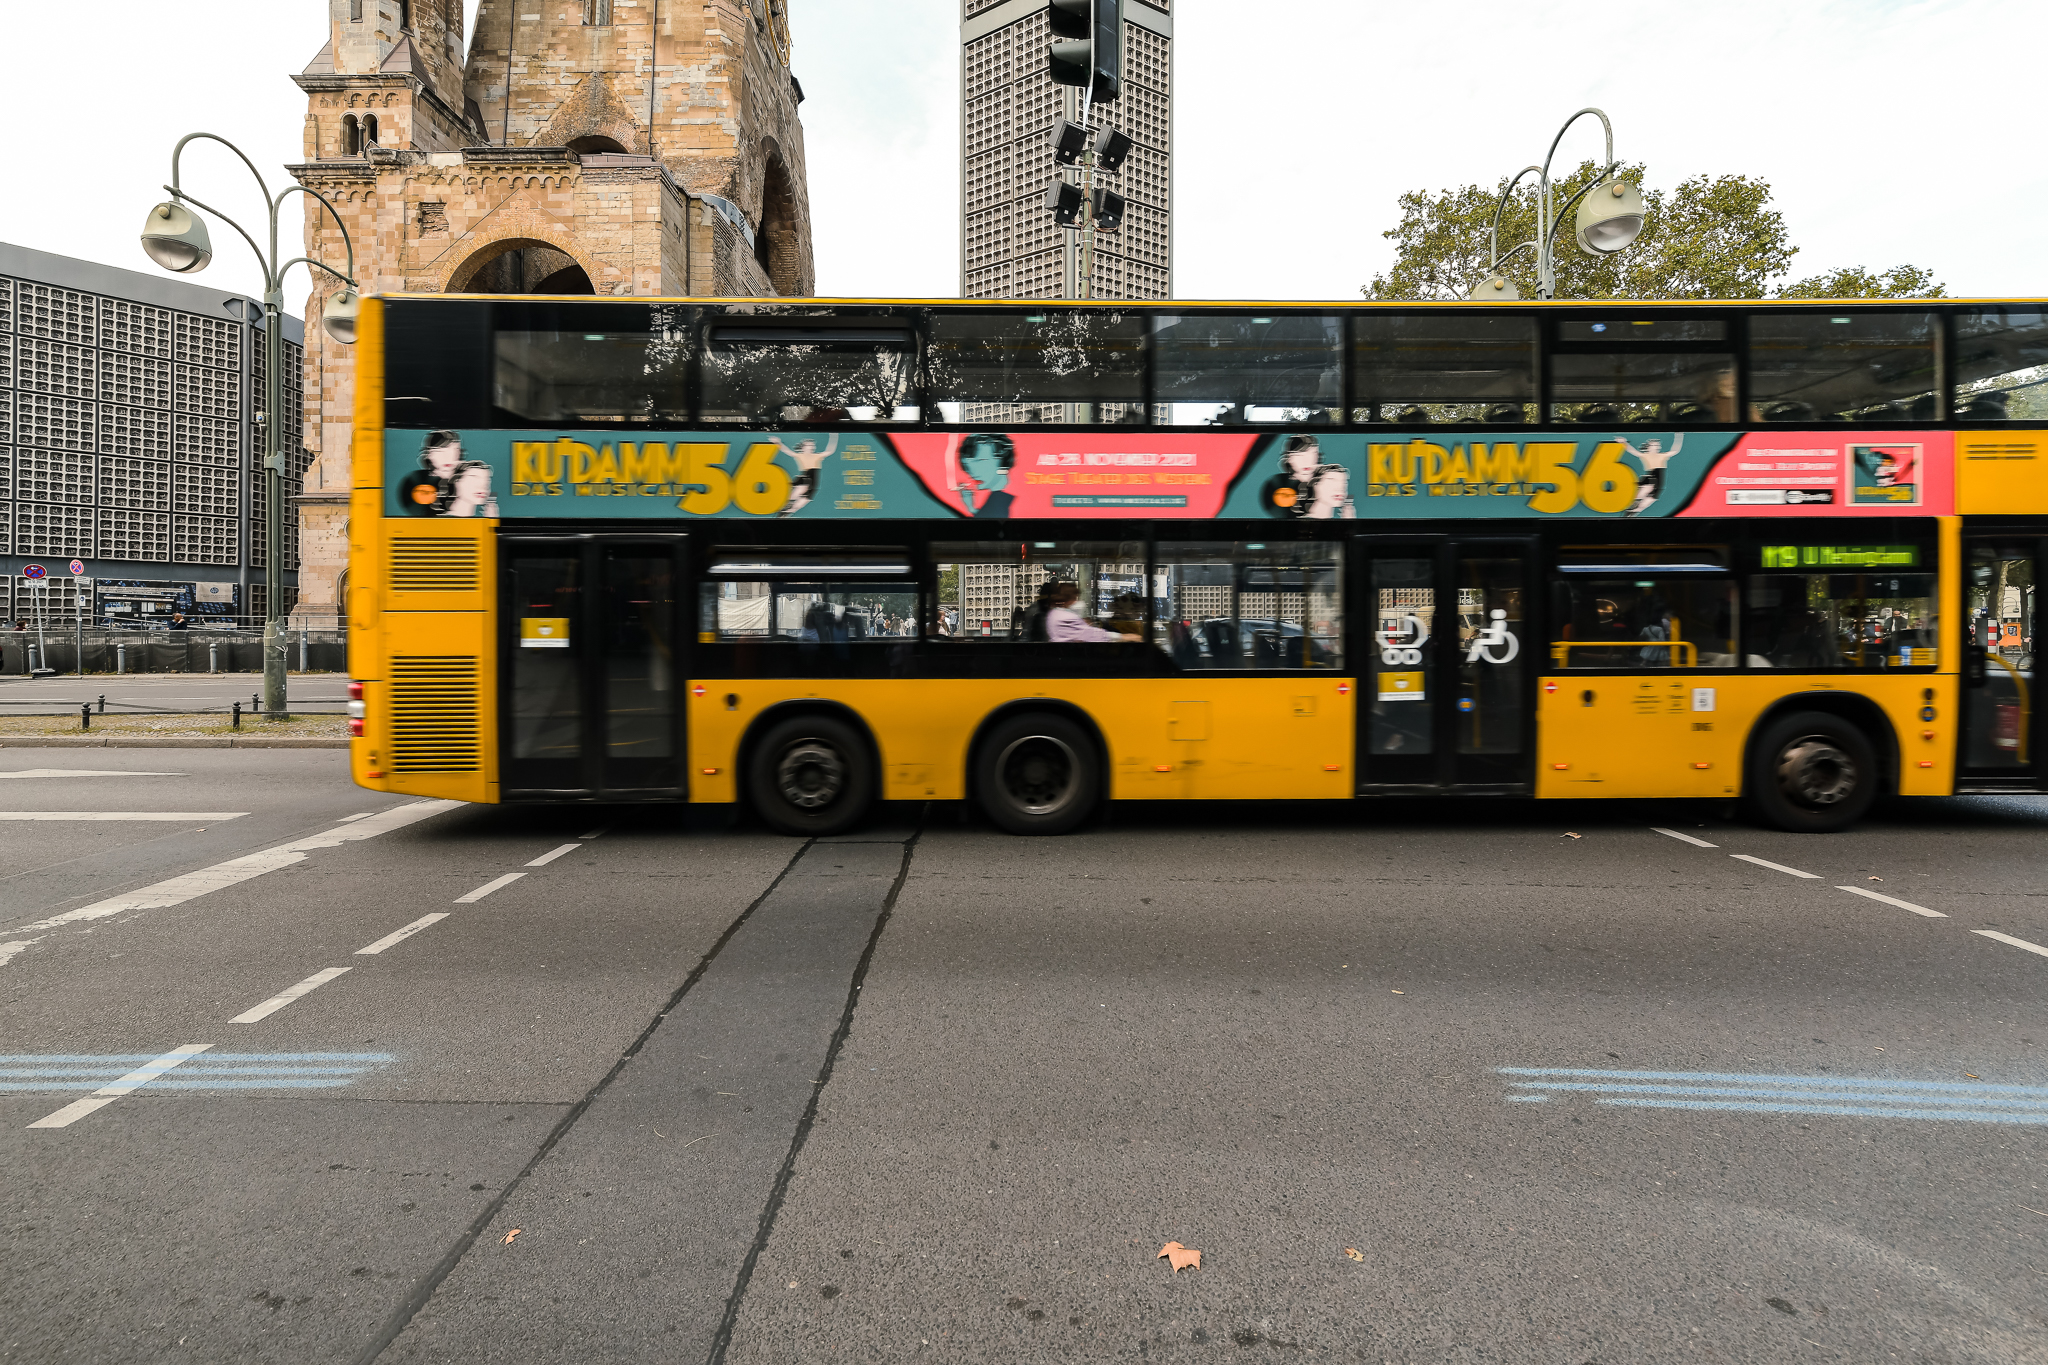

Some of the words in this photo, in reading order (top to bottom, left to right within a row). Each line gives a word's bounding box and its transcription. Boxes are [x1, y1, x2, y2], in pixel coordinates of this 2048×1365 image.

[511, 483, 564, 497] DAS
[575, 483, 687, 497] MUSICAL
[676, 442, 793, 515] 56
[1367, 483, 1418, 497] DAS
[1428, 483, 1537, 497] MUSICAL
[1526, 441, 1638, 514] 56
